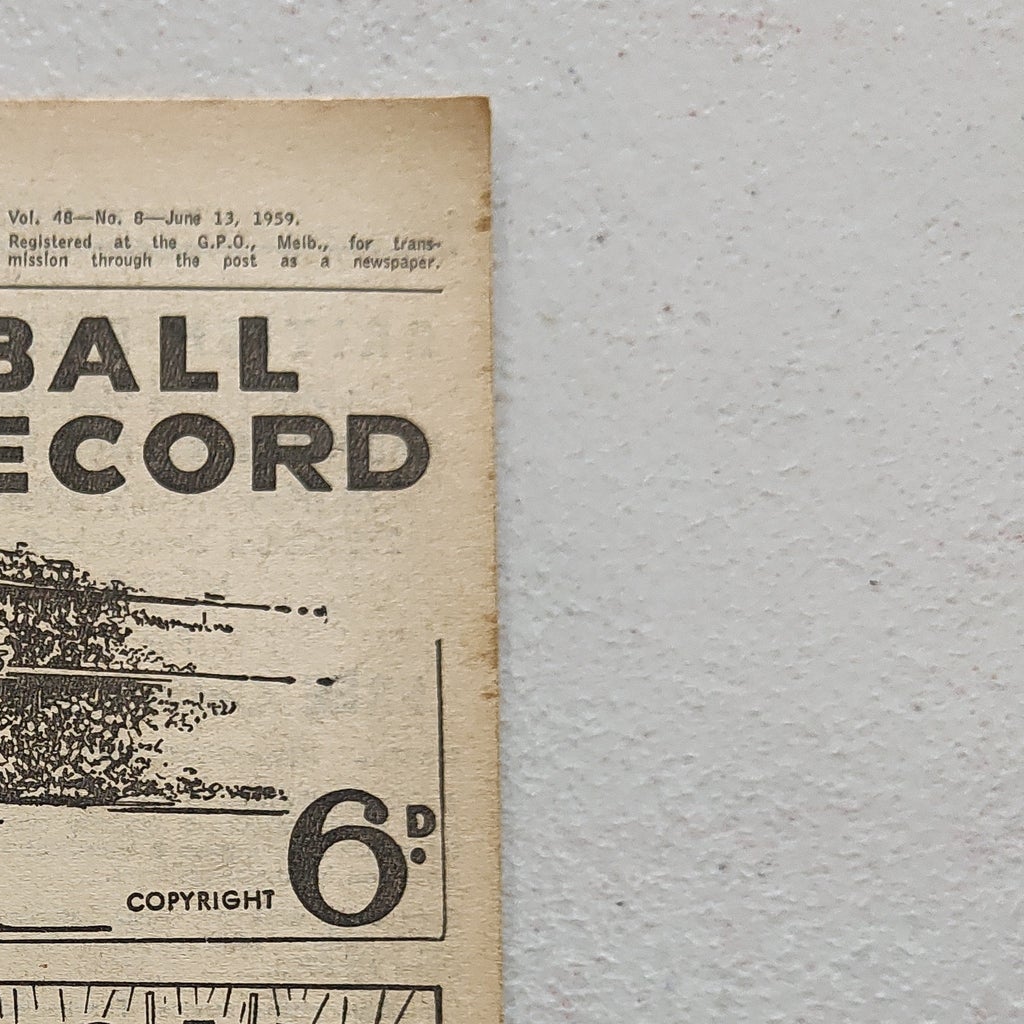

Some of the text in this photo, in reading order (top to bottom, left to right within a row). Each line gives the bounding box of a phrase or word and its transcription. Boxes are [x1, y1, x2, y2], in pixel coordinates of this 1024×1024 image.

[8, 209, 40, 226] Vol.
[214, 210, 240, 228] 13,
[253, 211, 300, 227] 1959.
[9, 233, 441, 252] Registered at the G.P.O., Melb., for trans-
[8, 251, 440, 272] mission through the post as a newspaper.
[126, 889, 275, 913] COPYRIGHT
